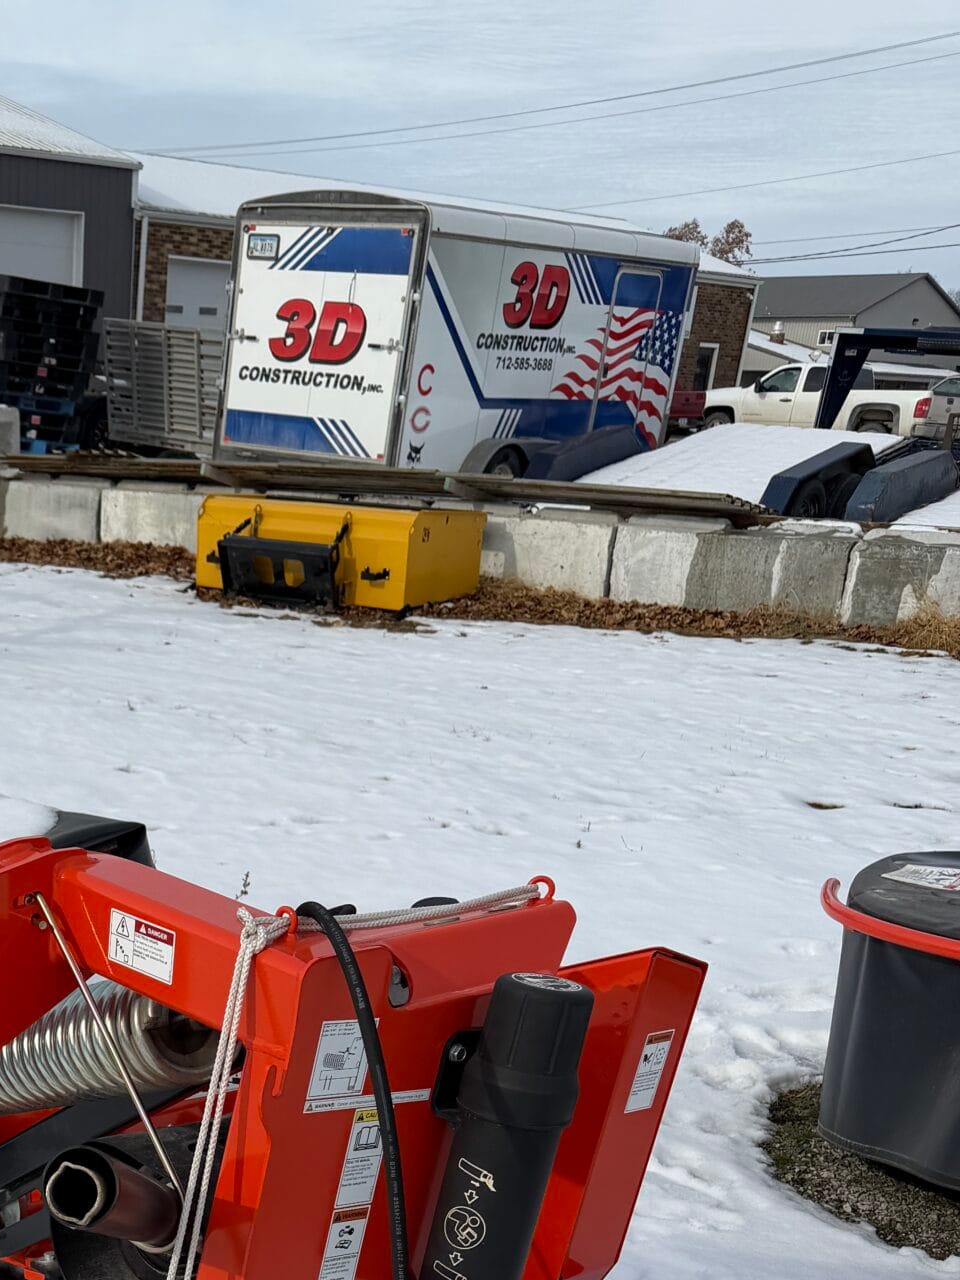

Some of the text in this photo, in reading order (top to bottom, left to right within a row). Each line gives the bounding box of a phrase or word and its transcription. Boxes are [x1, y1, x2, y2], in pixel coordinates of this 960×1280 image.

[503, 261, 571, 330] 3D
[268, 298, 367, 365] 3D
[496, 357, 553, 371] 712-585-3688
[147, 928, 168, 941] DANGER
[342, 1210, 368, 1220] WARNING
